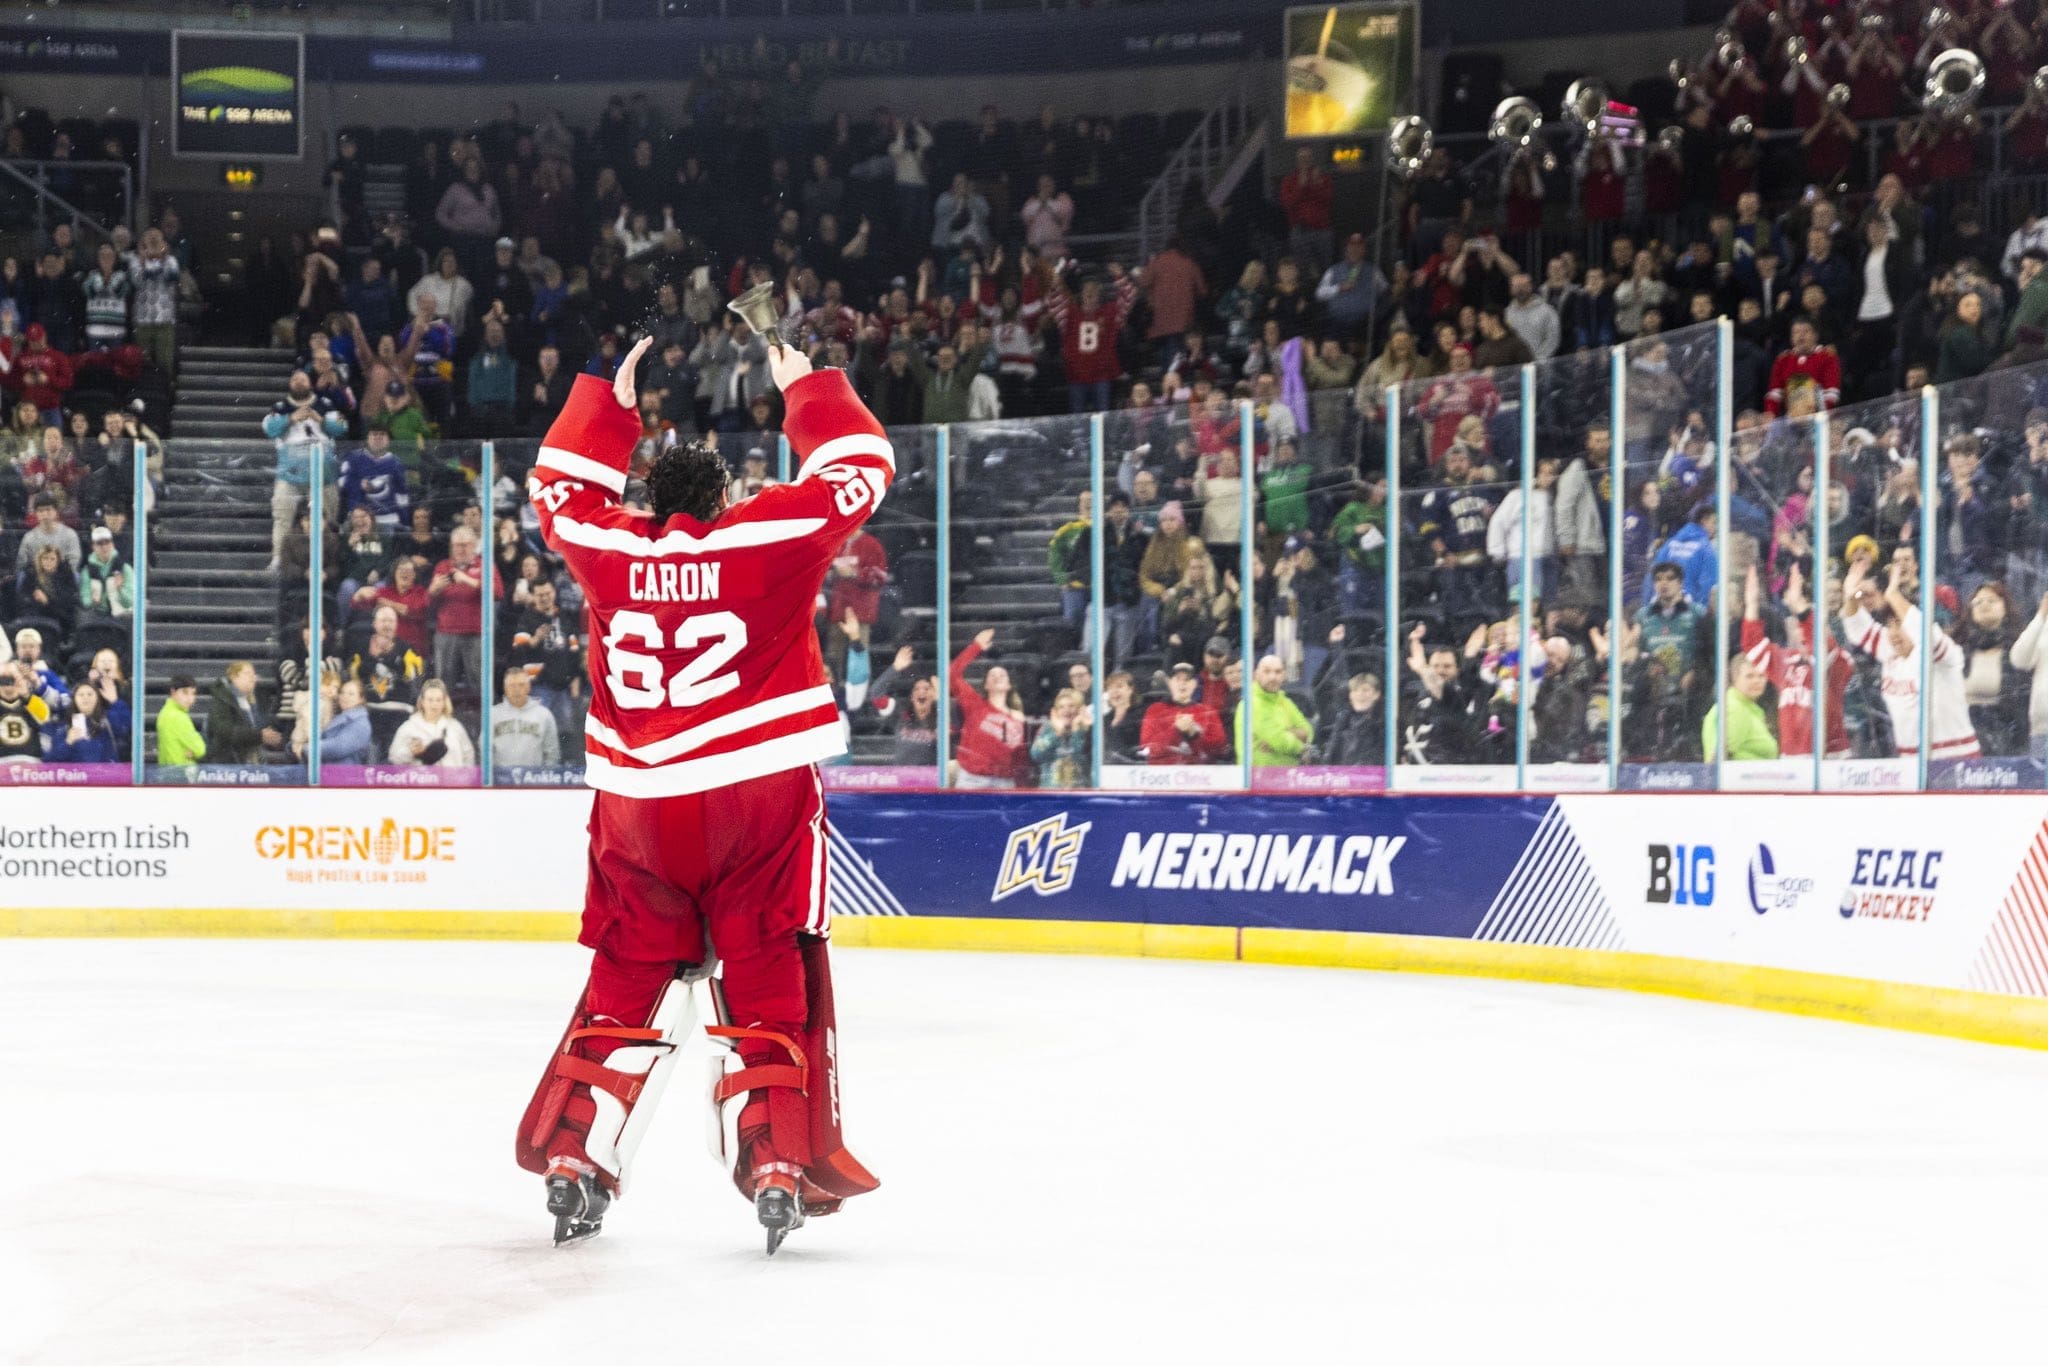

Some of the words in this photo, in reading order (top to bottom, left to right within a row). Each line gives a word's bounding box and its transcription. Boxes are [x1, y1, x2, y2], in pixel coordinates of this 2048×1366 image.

[629, 562, 721, 602] CARON
[602, 609, 749, 711] 62
[6, 719, 23, 739] B
[22, 768, 55, 782] Foot
[57, 768, 88, 782] Pain
[198, 768, 238, 783] Ankle
[240, 769, 270, 783] Pain
[376, 770, 408, 784] Foot
[410, 770, 439, 784] Pain
[523, 770, 562, 784] Ankle
[563, 770, 585, 784] Pai
[1140, 770, 1171, 786] Foot
[124, 824, 189, 849] Irish
[1110, 832, 1407, 895] MERRIMACK
[1850, 848, 1944, 890] ECAC
[1858, 892, 1935, 923] HOCKEY
